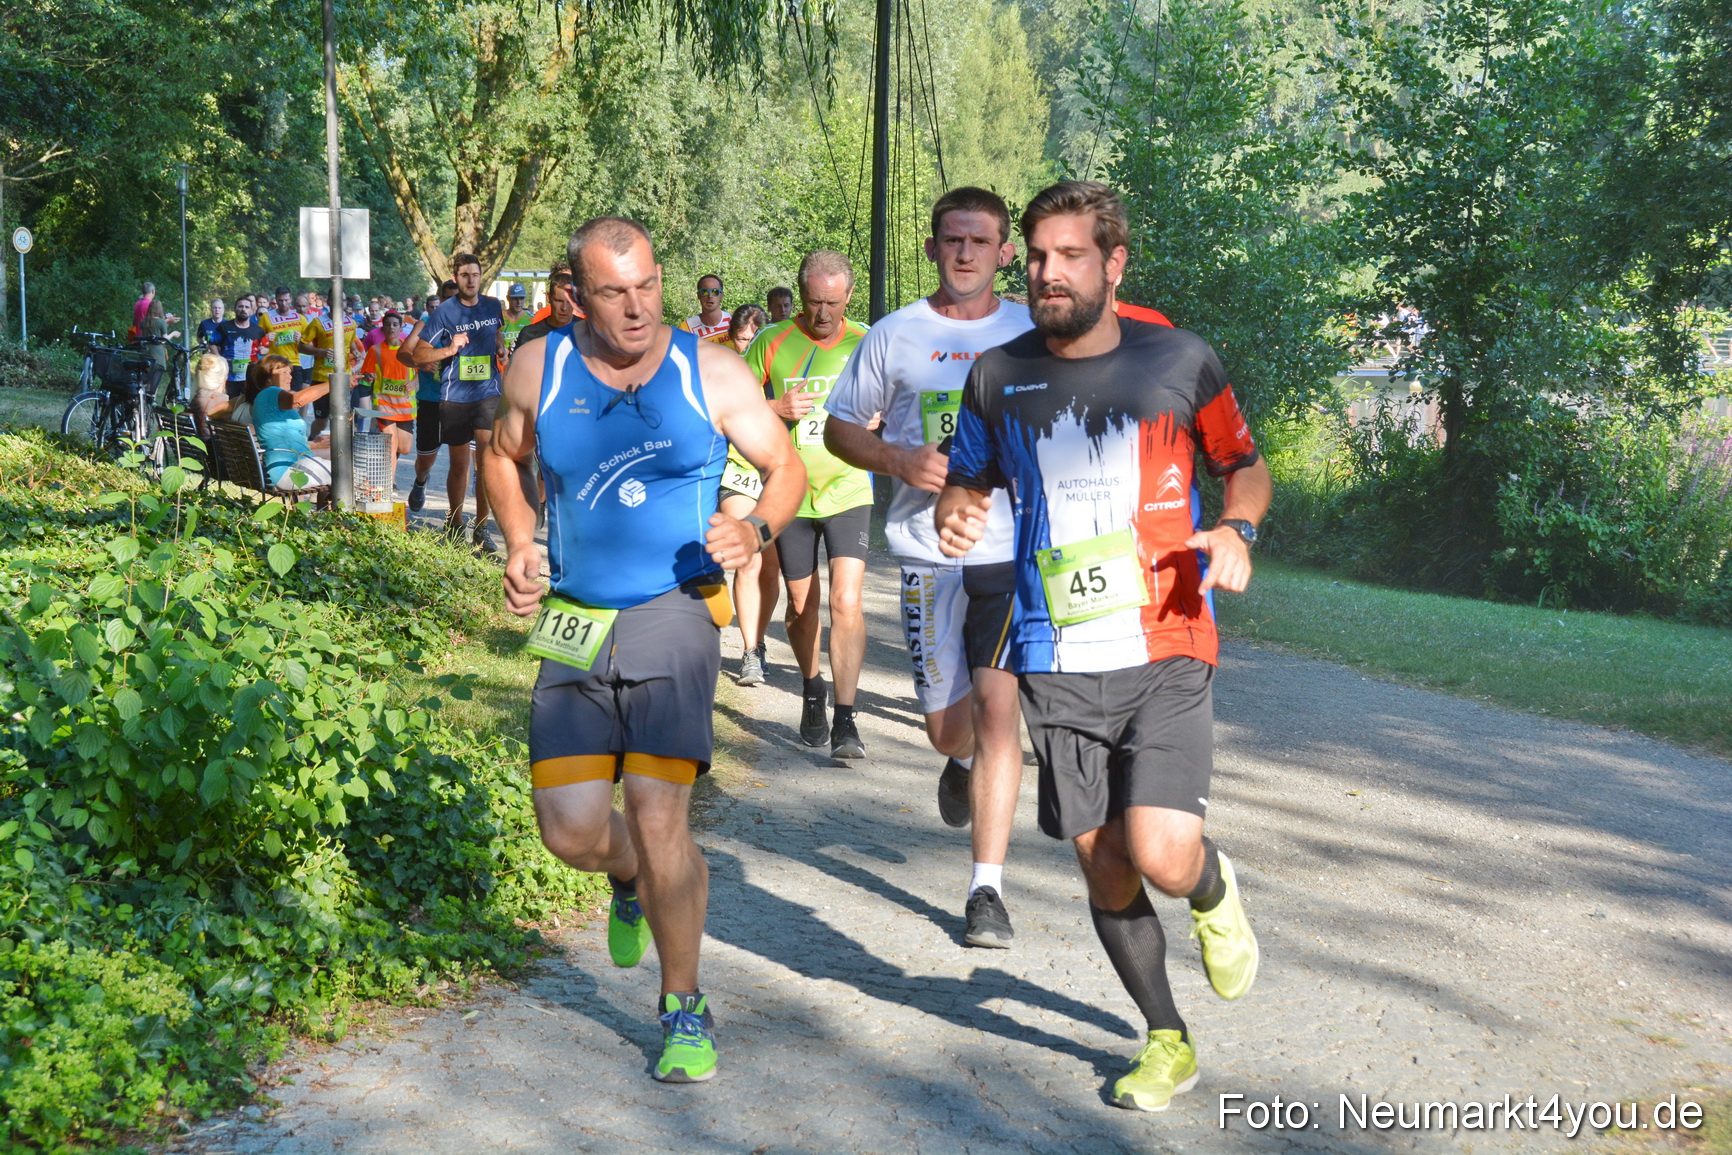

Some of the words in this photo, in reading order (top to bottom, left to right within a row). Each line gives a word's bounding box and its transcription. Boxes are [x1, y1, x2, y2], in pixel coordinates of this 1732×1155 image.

[455, 323, 475, 332] EURO
[237, 362, 246, 370] 47
[466, 364, 485, 374] 512
[384, 383, 405, 393] 2086
[576, 472, 601, 502] Team
[598, 446, 642, 473] Schick
[643, 438, 673, 452] Bau
[732, 473, 758, 491] 241
[1057, 476, 1120, 490] AUTOHAUS
[1065, 489, 1111, 502] MÜLLER
[1069, 565, 1108, 598] 45
[922, 573, 936, 647] EQUIPMENT
[1067, 600, 1089, 611] Bayer
[538, 608, 594, 646] 1181
[904, 571, 931, 689] MASTERS
[535, 633, 554, 645] Schick
[554, 640, 580, 653] Matthias
